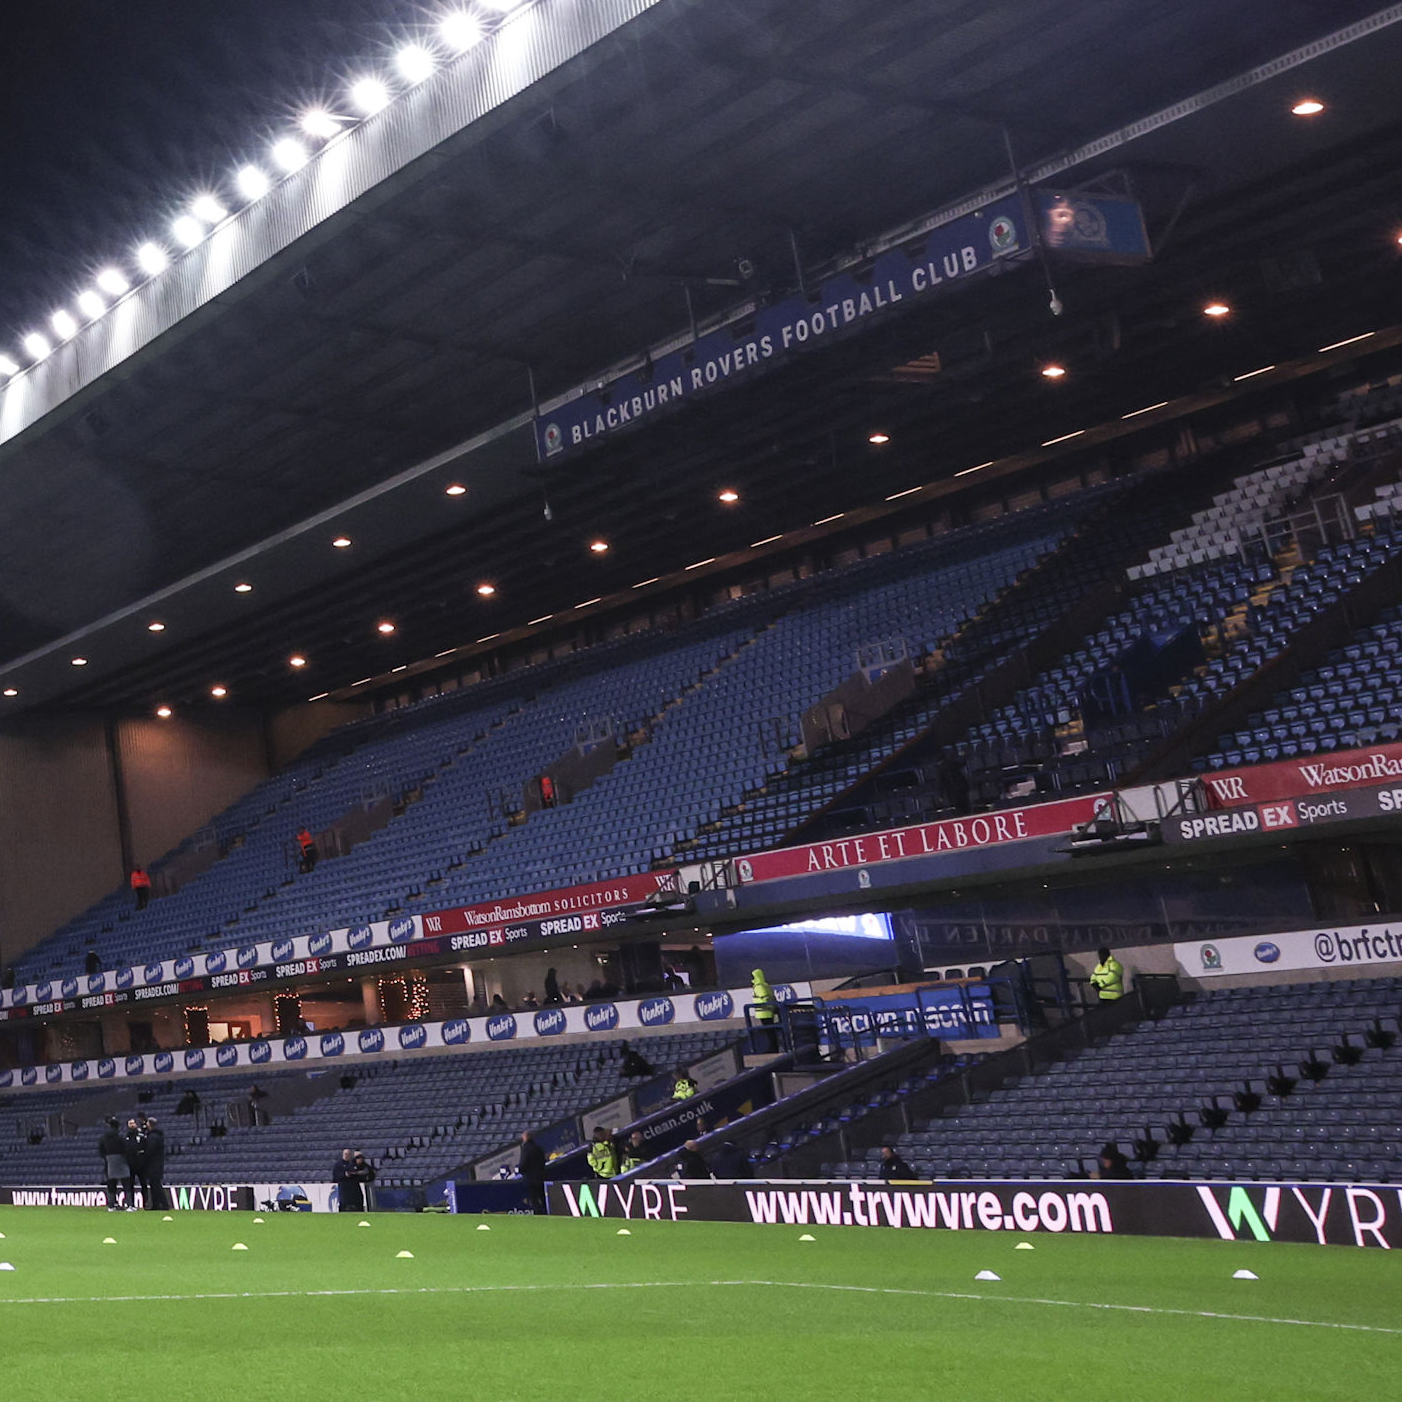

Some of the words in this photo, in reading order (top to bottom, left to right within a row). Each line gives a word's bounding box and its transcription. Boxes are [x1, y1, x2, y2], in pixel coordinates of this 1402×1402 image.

[572, 377, 683, 445] BLACKBURN
[691, 335, 773, 390] ROVERS
[782, 280, 902, 348] FOOTBALL
[912, 246, 978, 292] CLUB
[1211, 776, 1248, 800] WR
[1180, 810, 1259, 840] SPREAD
[1262, 806, 1293, 827] EX
[1298, 799, 1348, 823] Sports
[806, 840, 867, 873] ARTE
[877, 832, 907, 860] ET
[919, 812, 1029, 853] LABORE
[464, 900, 551, 927] WatsonRamsbottom
[554, 887, 630, 911] SOLICITORS
[425, 915, 442, 933] WR
[541, 918, 582, 937] SPREAD
[584, 914, 599, 928] EX
[451, 932, 487, 951] SPREAD
[489, 930, 503, 944] EX
[505, 926, 529, 940] Sports
[212, 974, 238, 988] SPREAD
[239, 972, 250, 983] EX
[276, 961, 306, 978] SPREAD
[307, 960, 317, 972] EX
[319, 958, 337, 971] Sports
[587, 1005, 615, 1028] Venky's
[641, 999, 671, 1025] Venky's
[698, 991, 729, 1018] Venky's
[488, 1014, 513, 1036] Venky's
[537, 1007, 563, 1030] Venky's
[562, 1183, 688, 1221] WYRE
[745, 1183, 1114, 1233] www.trywyre.com
[1196, 1185, 1402, 1250] WYR
